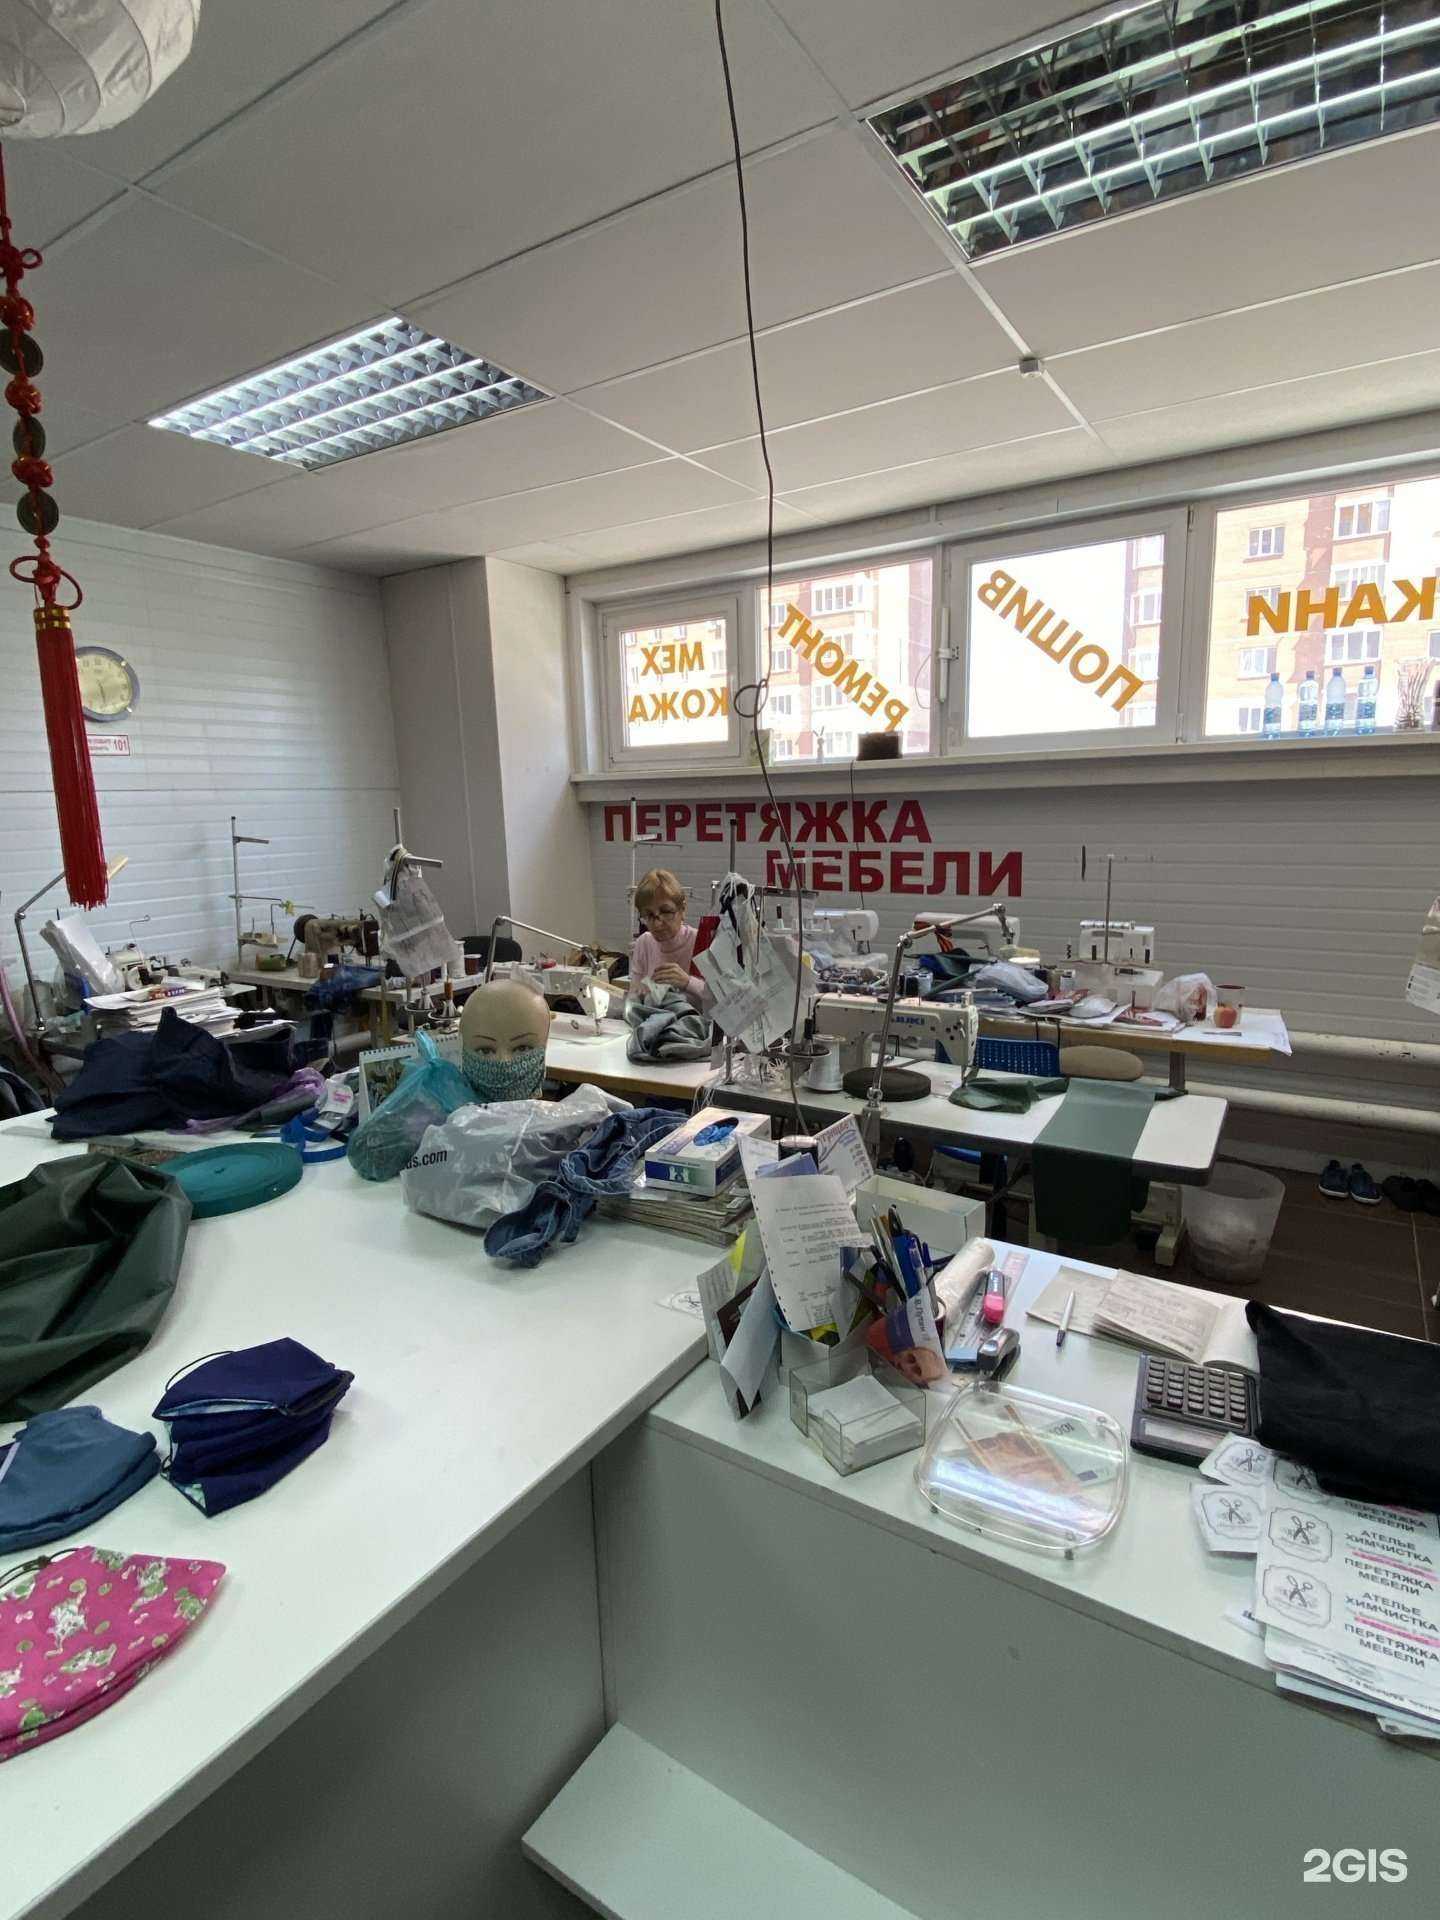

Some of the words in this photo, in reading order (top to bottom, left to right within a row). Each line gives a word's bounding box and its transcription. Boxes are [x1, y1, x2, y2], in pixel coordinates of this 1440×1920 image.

[114, 739, 128, 751] 101
[604, 800, 932, 843] ПЕРЕТЯЖКА
[766, 850, 1023, 897] МЕБЕЛИ
[1344, 1500, 1427, 1528] ПЕРЕТЯЖКА
[1358, 1512, 1415, 1532] МЕБЕЛИ
[1345, 1532, 1432, 1565] ХИМЧИСТКА
[1361, 1530, 1416, 1550] АТЕЛЬЕ
[1344, 1557, 1434, 1591] ПЕРЕТЯЖКА
[1359, 1571, 1420, 1596] МЕБЕЛИ
[1345, 1595, 1439, 1632] ХИМЧИСТКА
[1362, 1592, 1421, 1616] АТЕЛЬЕ
[1345, 1623, 1440, 1662] ПЕРЕТЯЖКА
[1359, 1639, 1425, 1668] МЕБЕЛИ
